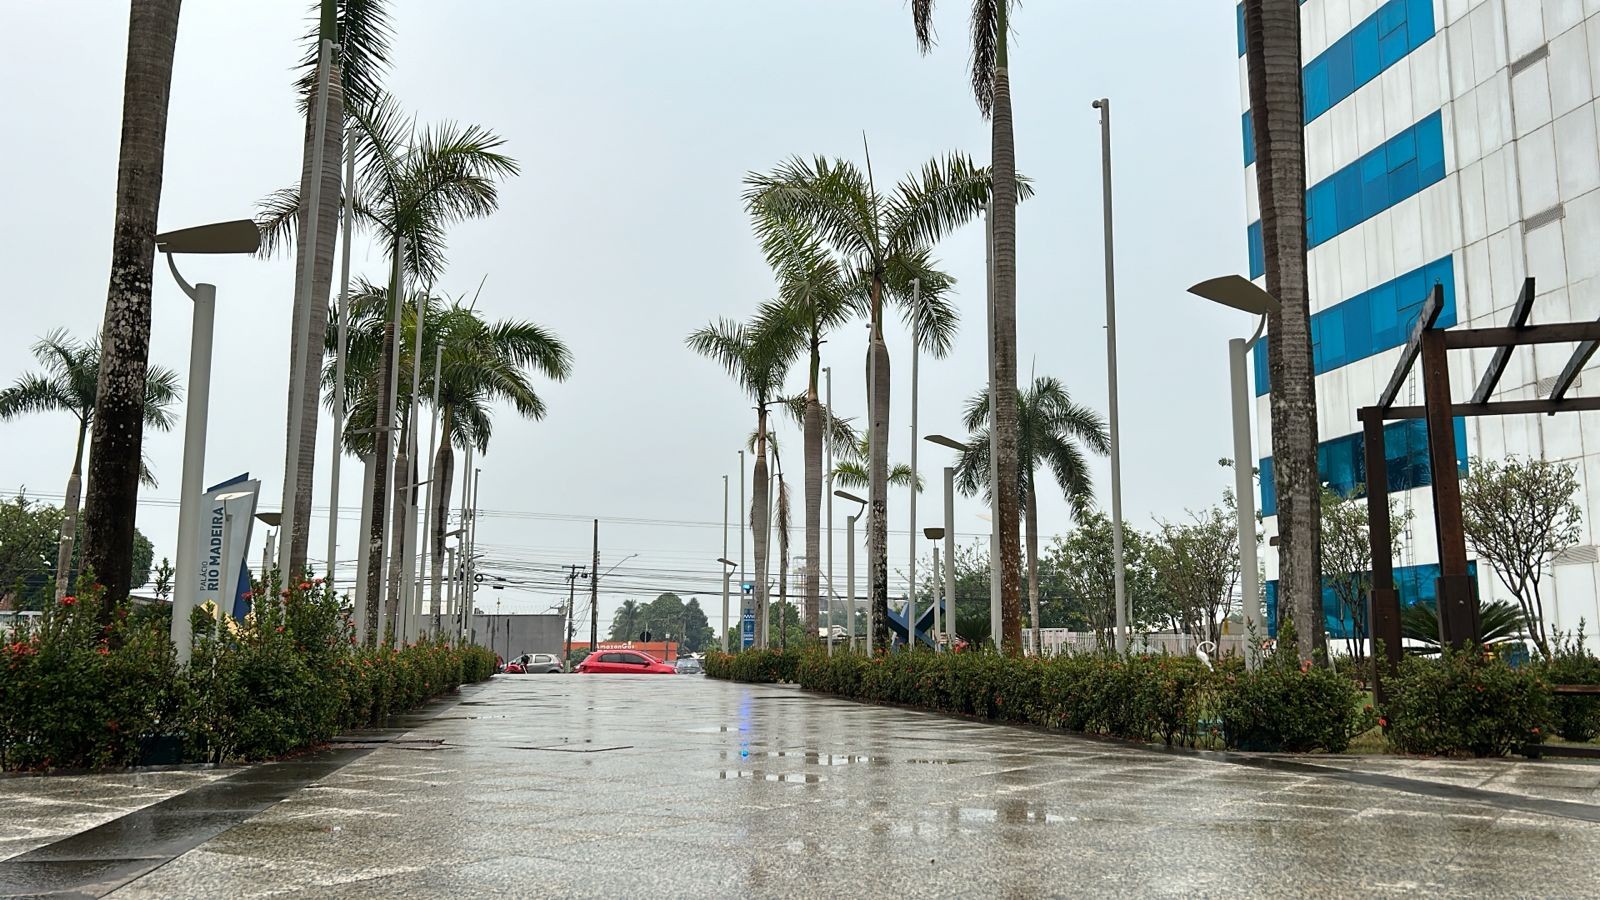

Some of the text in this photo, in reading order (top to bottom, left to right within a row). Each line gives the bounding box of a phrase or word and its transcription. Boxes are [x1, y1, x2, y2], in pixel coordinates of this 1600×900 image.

[200, 561, 208, 591] PALÁCIO
[208, 507, 224, 591] RIO MADEIRA
